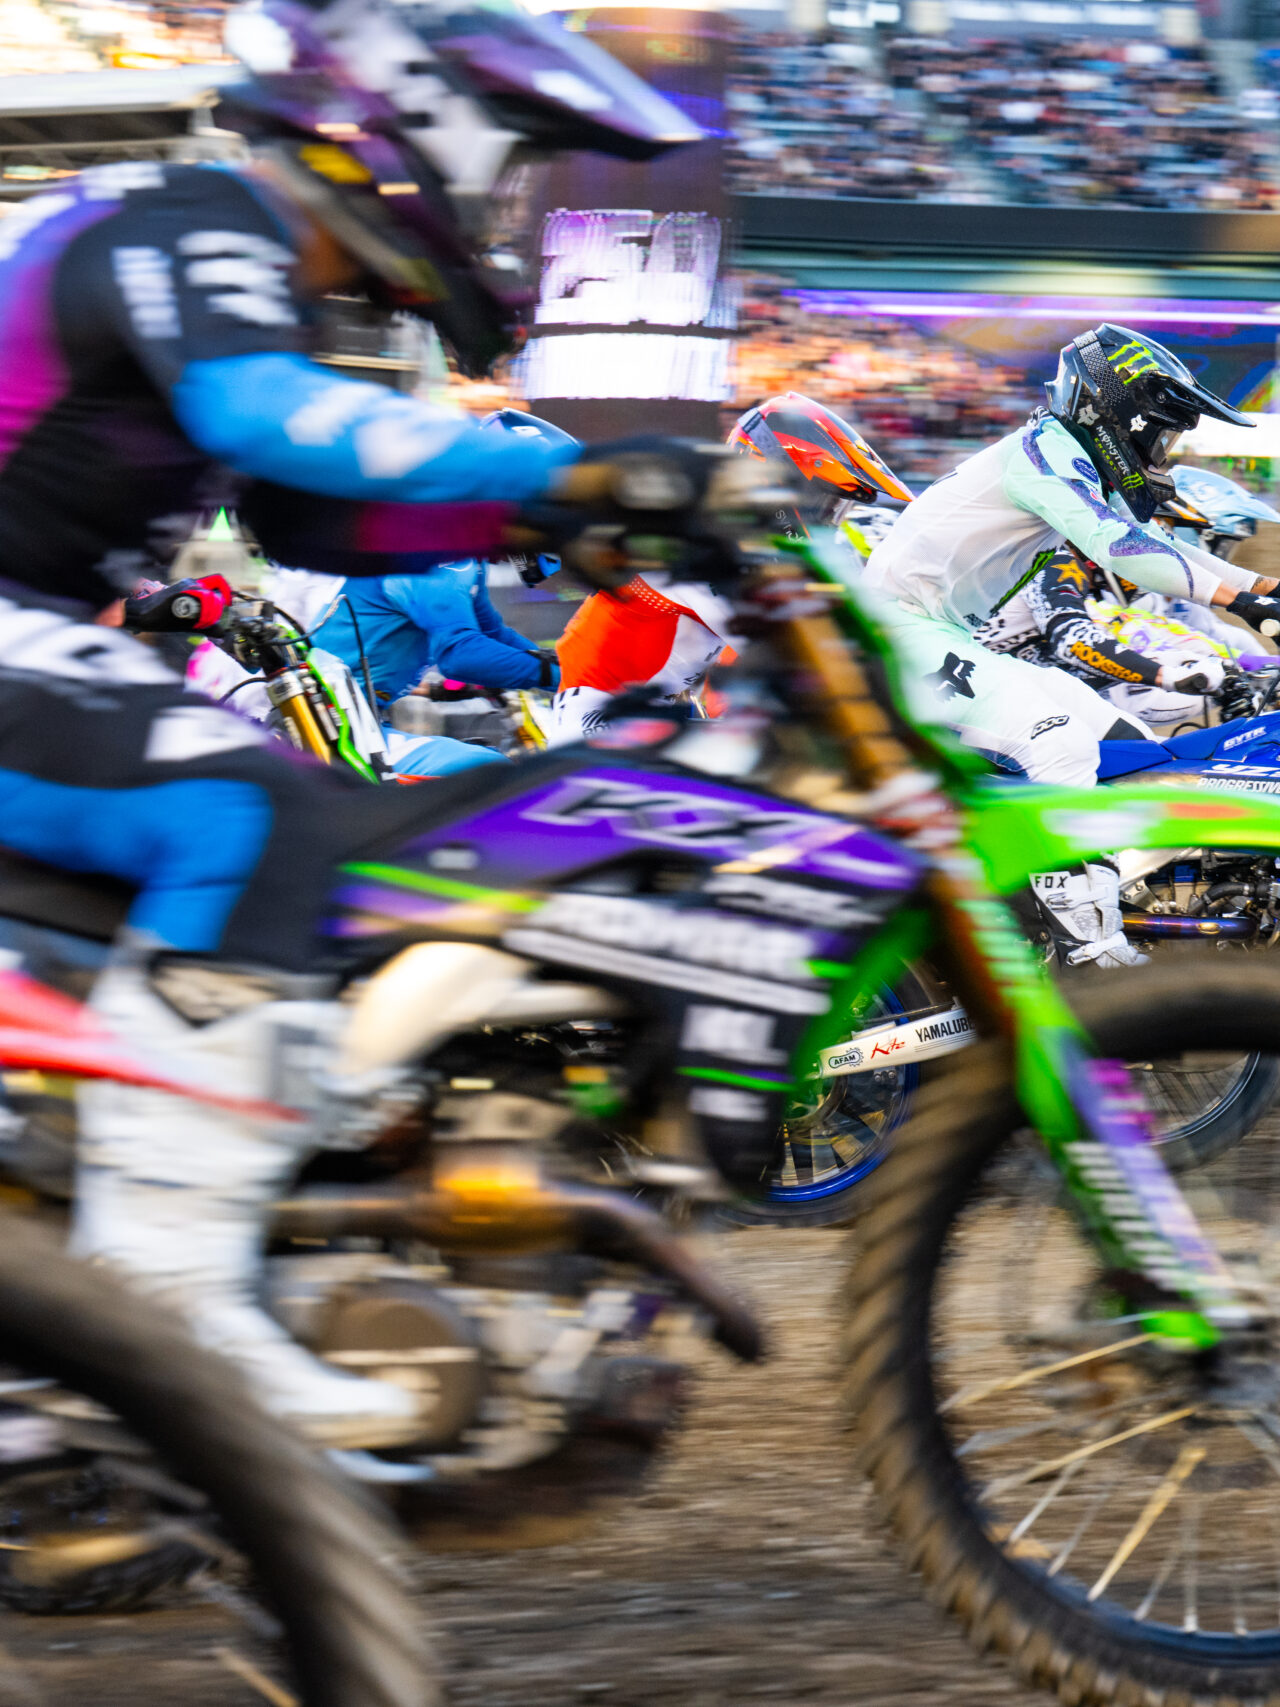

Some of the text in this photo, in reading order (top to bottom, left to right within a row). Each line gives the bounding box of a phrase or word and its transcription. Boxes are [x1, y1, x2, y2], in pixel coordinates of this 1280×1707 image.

[1069, 640, 1144, 682] ROCKSTAR
[1034, 875, 1069, 888] FOX
[834, 1054, 857, 1066] AFAM
